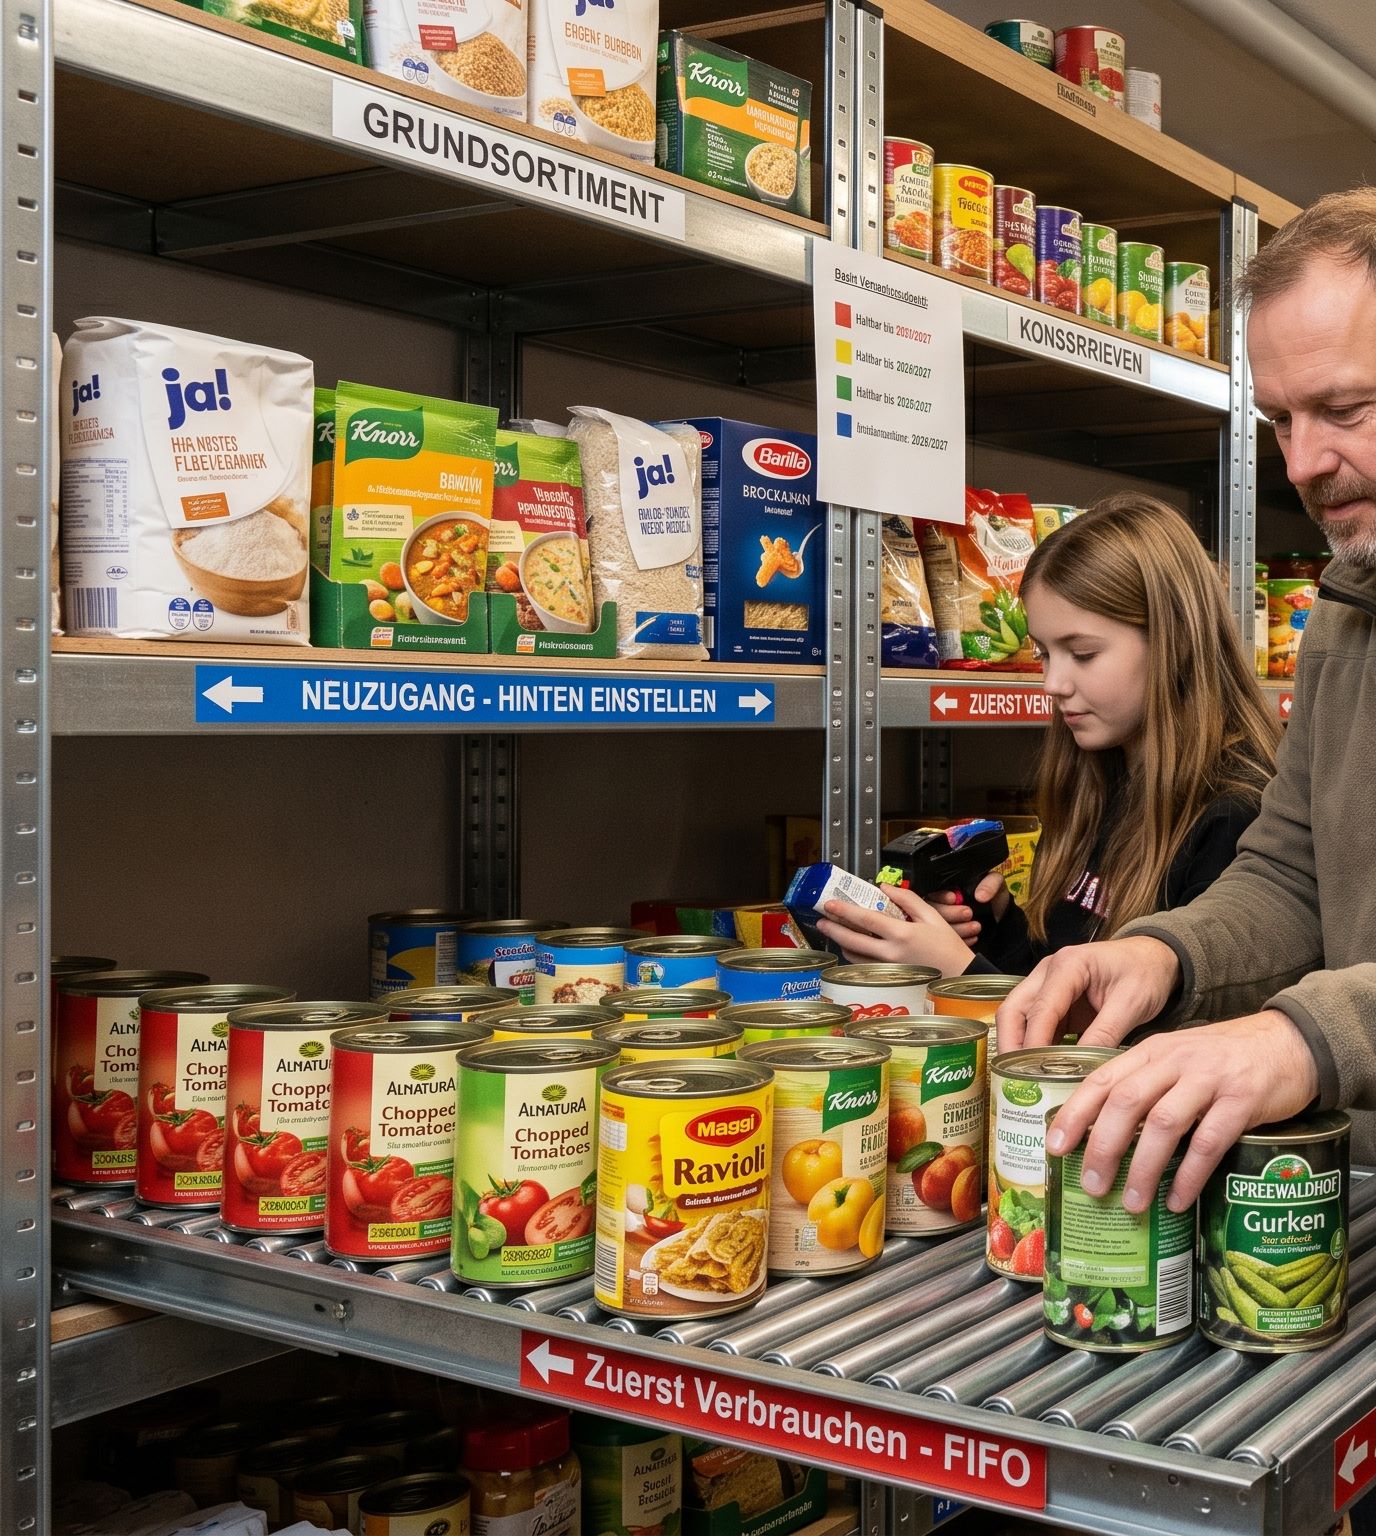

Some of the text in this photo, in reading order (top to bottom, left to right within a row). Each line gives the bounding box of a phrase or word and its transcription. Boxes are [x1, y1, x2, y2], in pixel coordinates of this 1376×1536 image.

[688, 62, 745, 97] Knorr
[363, 102, 665, 225] GRUNDSORTIMENT
[856, 349, 882, 367] Haltbar
[72, 374, 101, 416] ja!
[162, 367, 232, 430] ja!
[350, 419, 421, 449] Knorr
[758, 447, 807, 470] Barilla
[633, 453, 675, 500] ja!
[302, 680, 475, 712] NEUZUGANG
[498, 684, 583, 713] HINTEN
[590, 686, 717, 713] EINSTELLEN
[969, 694, 1023, 716] ZUERST
[387, 1076, 456, 1096] ALNATURA
[926, 1065, 975, 1085] Knorr
[518, 1097, 587, 1118] ALNATURA
[828, 1089, 879, 1111] Knorr
[382, 1101, 456, 1124] Chopped
[378, 1120, 456, 1138] Tomatoes
[514, 1121, 590, 1146] Chopped
[697, 1114, 755, 1139] Maggi
[511, 1138, 591, 1161] Tomatoes
[673, 1144, 766, 1187] Ravioli
[1231, 1176, 1338, 1200] SPREEWALDHOF
[1243, 1210, 1325, 1234] Gurken
[584, 1352, 685, 1408] Zuerst
[693, 1376, 908, 1461] Verbrauchen
[943, 1433, 1031, 1488] FIFO
